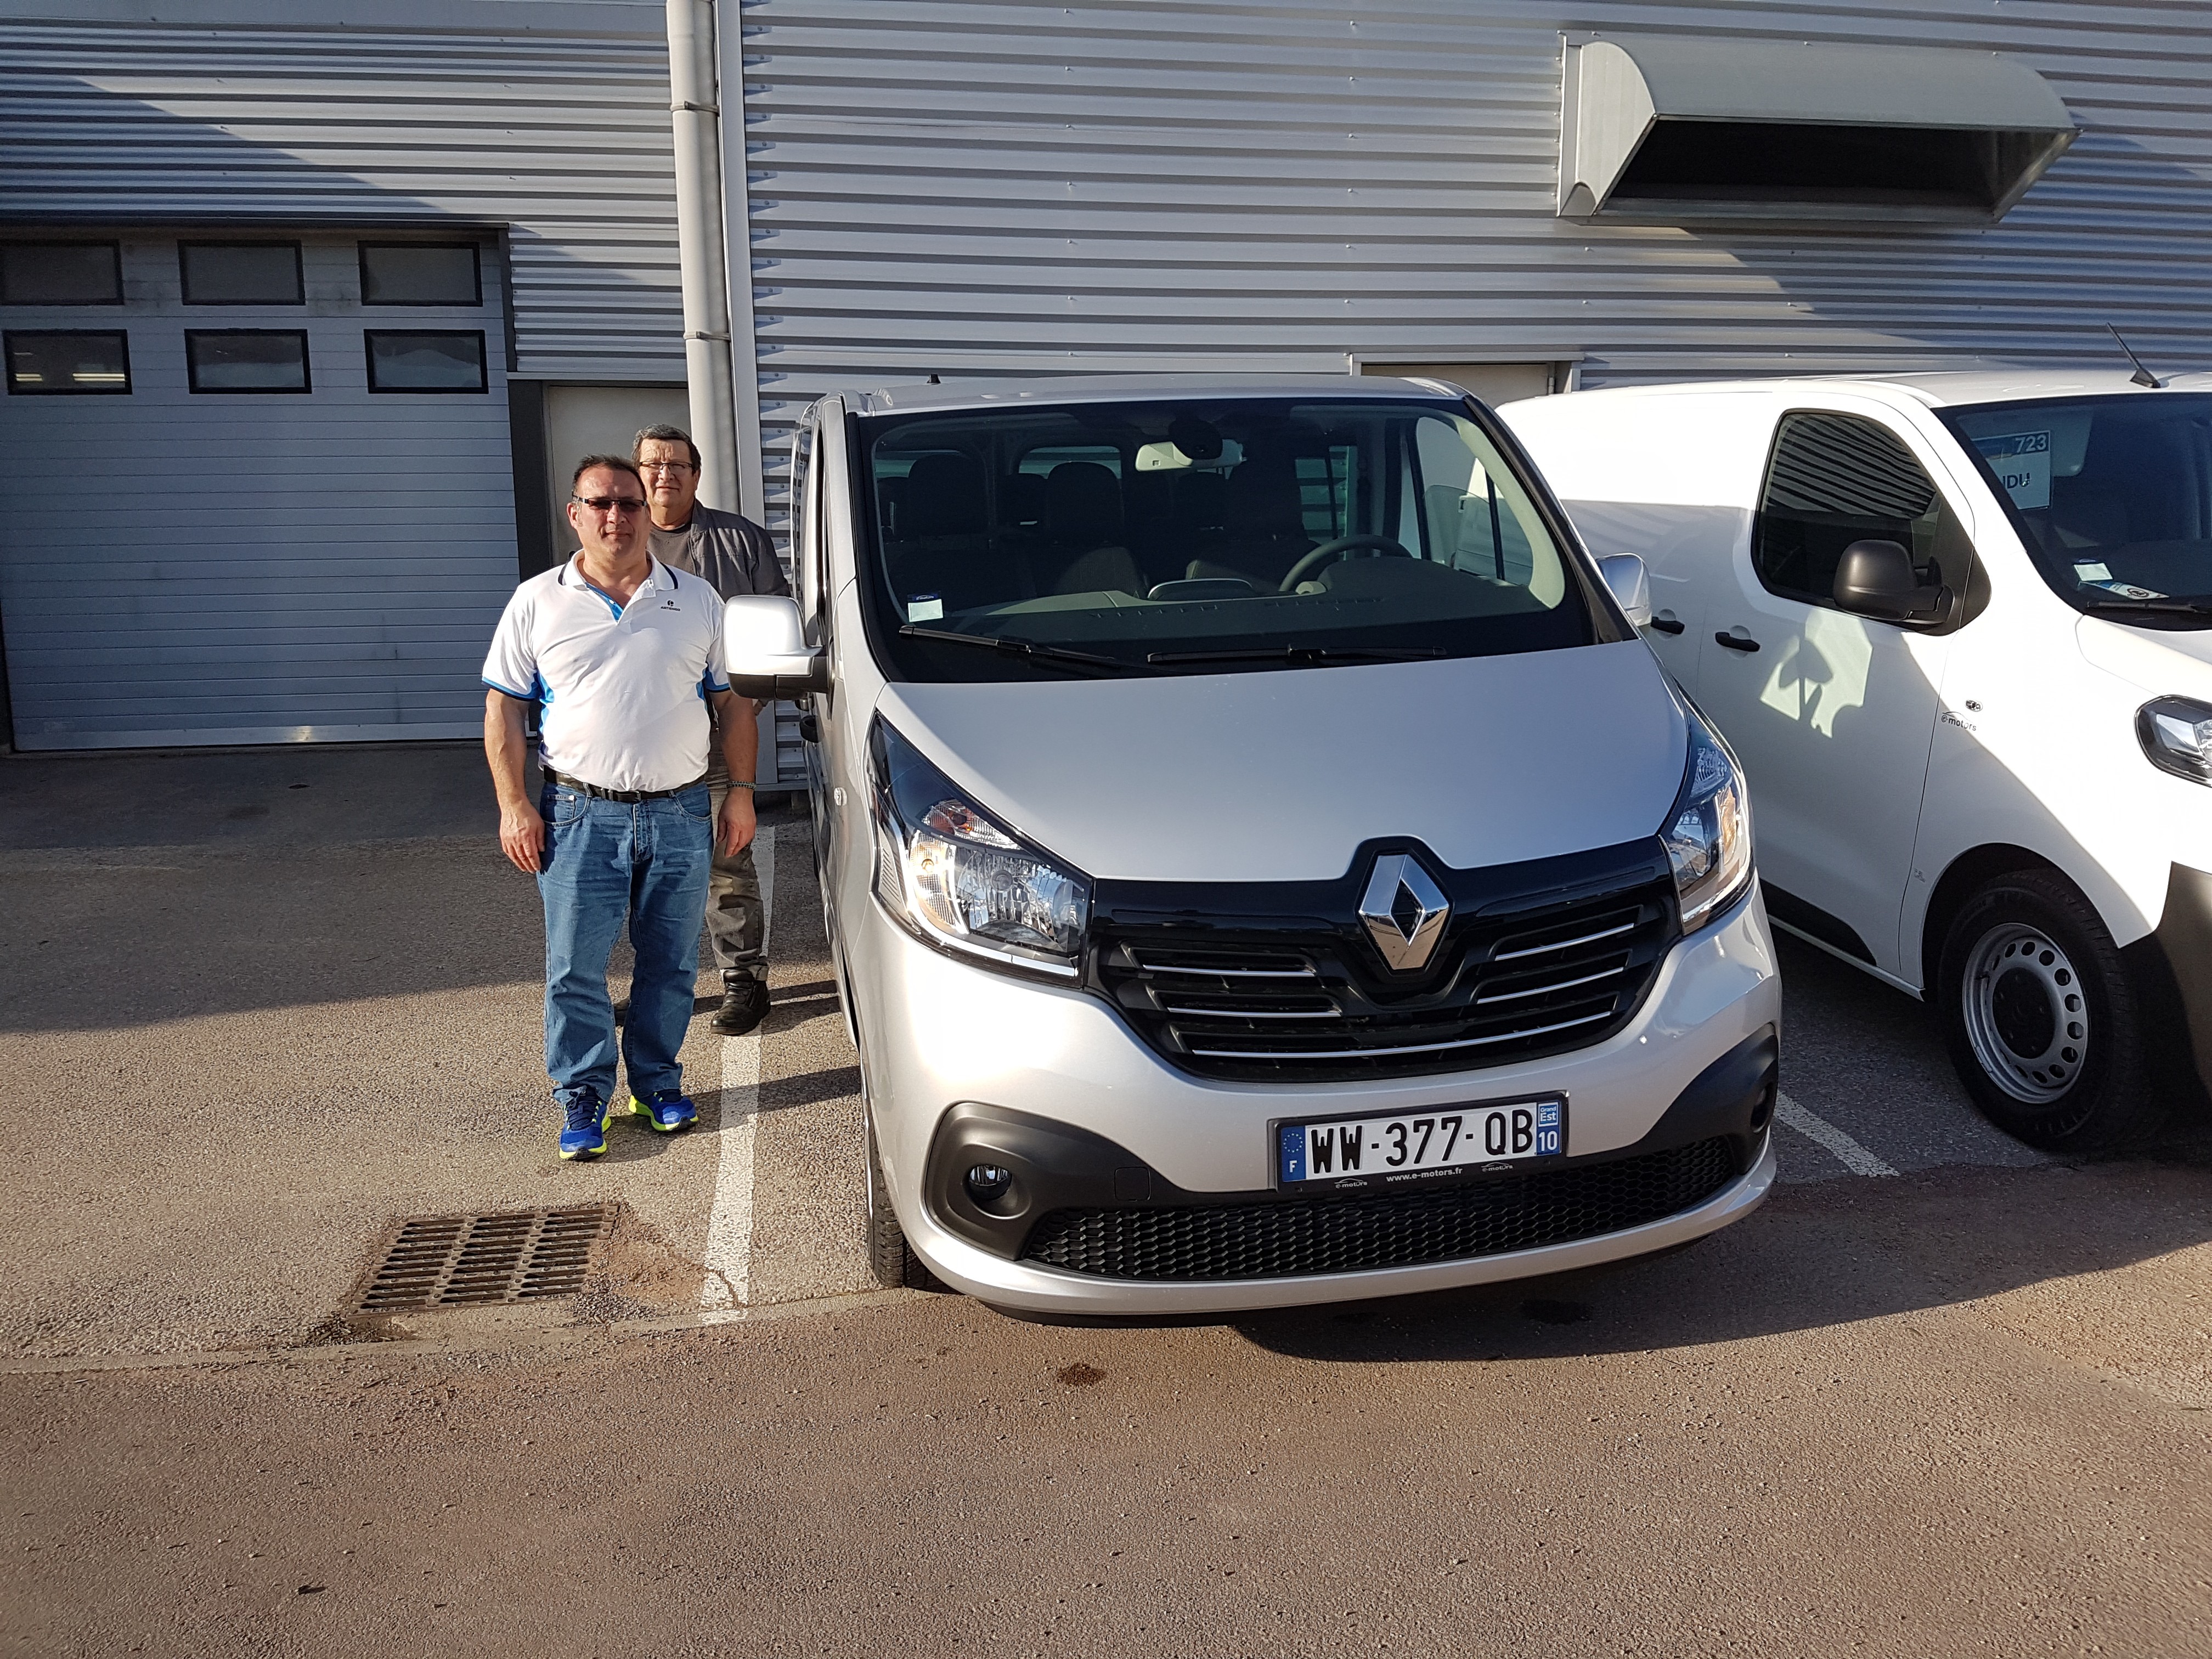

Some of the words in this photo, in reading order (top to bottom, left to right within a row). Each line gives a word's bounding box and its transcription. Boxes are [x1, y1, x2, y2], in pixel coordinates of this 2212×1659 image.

[2015, 434, 2047, 453] 723
[1540, 1112, 1557, 1122] Est
[1538, 1130, 1558, 1152] 10
[1289, 1160, 1297, 1173] F
[1386, 1167, 1463, 1182] www.e-motors.fr
